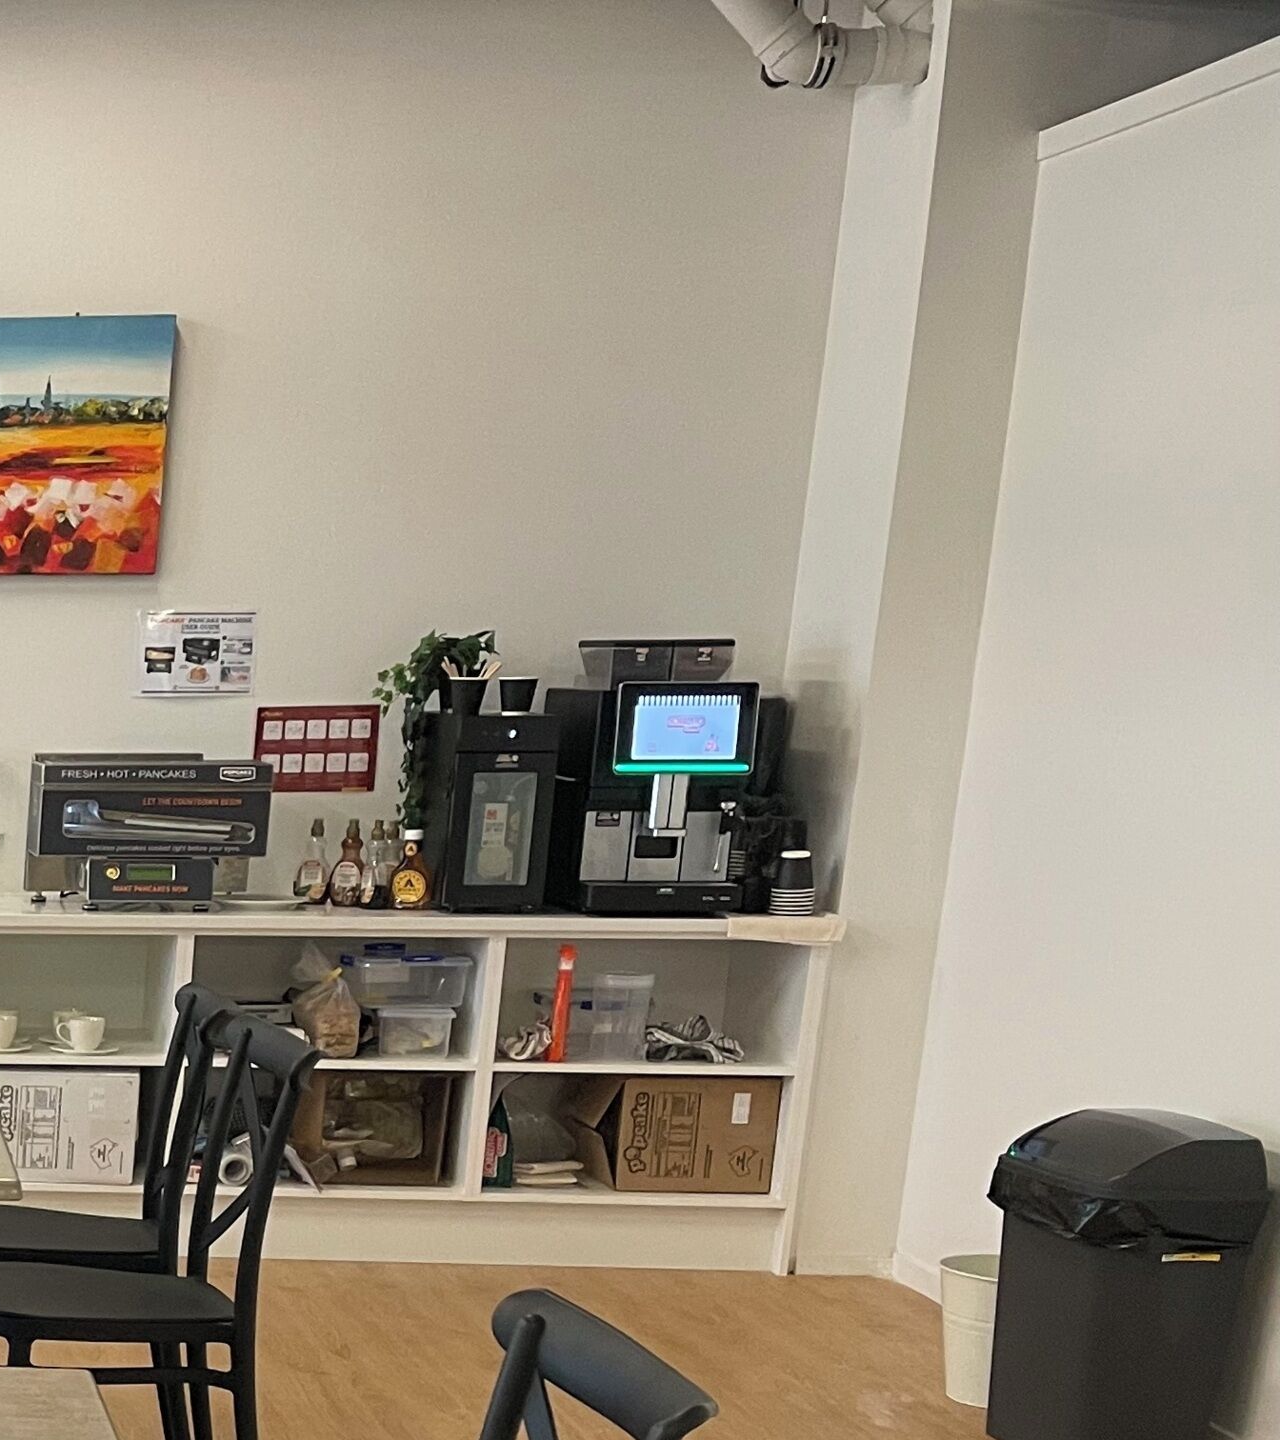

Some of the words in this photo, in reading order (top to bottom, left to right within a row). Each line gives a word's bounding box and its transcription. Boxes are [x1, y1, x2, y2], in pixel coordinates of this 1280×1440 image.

[61, 769, 98, 778] FRESH
[106, 769, 129, 778] HOT
[138, 769, 197, 779] PANCAKES
